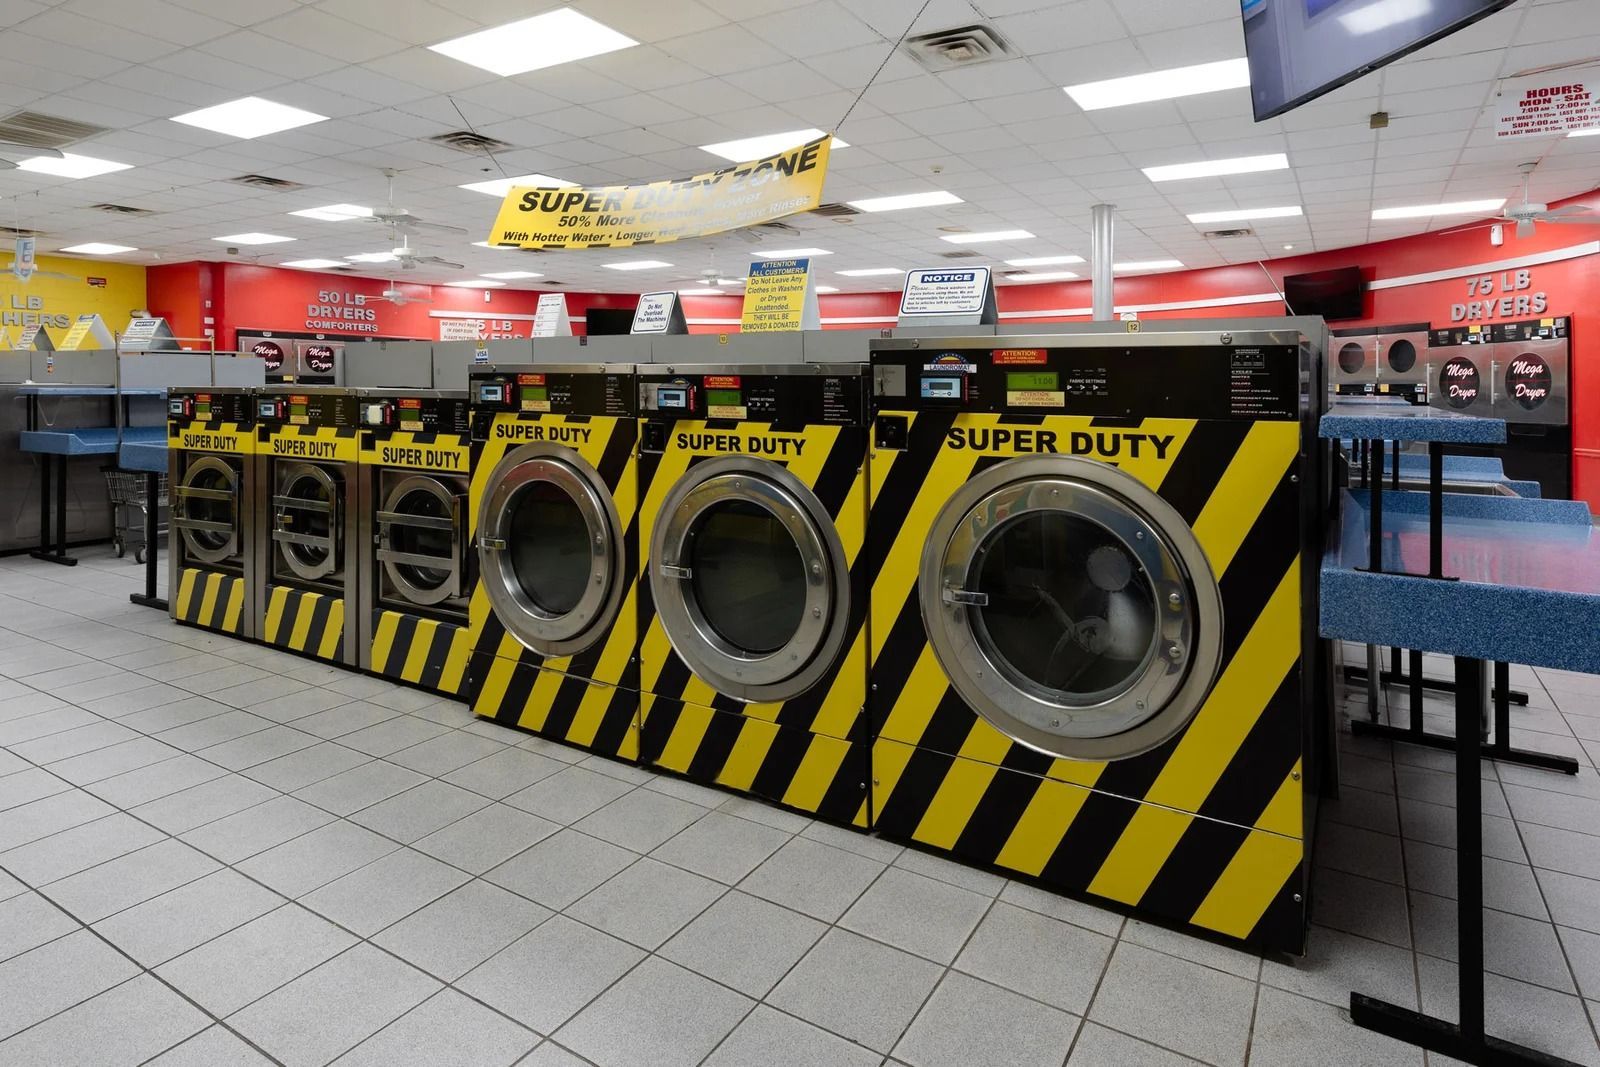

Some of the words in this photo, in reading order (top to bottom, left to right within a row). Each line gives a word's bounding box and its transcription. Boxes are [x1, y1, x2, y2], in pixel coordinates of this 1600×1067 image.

[1527, 84, 1584, 98] HOURS
[1519, 97, 1552, 107] MON
[1564, 92, 1592, 102] SAT
[1556, 101, 1579, 110] 12:00
[1565, 115, 1589, 123] 10:30
[518, 190, 625, 214] SUPER
[632, 175, 723, 210] DUTY
[728, 144, 820, 192] ZONE
[558, 215, 590, 228] 50%
[596, 214, 636, 226] More
[503, 231, 529, 241] With
[532, 232, 568, 242] Hotter
[572, 232, 605, 242] Water
[616, 230, 653, 241] Longer
[762, 260, 796, 268] ATTENTION
[765, 268, 804, 276] CUSTOMERS
[924, 274, 972, 282] NOTICE
[790, 276, 802, 284] Any
[1466, 276, 1494, 296] 75
[1501, 269, 1531, 292] LB
[11, 294, 44, 310] LB
[318, 290, 340, 303] 50
[345, 292, 366, 306] LB
[768, 295, 787, 303] Dryers
[308, 304, 376, 321] DRYERS
[1451, 291, 1548, 322] DRYERS
[306, 320, 378, 332] COMFORTERS
[492, 320, 513, 332] LB
[254, 346, 278, 356] Mega
[309, 348, 330, 357] Mega
[265, 360, 280, 369] ryer
[311, 360, 332, 369] Dryer
[1447, 364, 1475, 378] Mega
[1512, 360, 1543, 375] Mega
[1449, 384, 1476, 399] Dryer
[1515, 383, 1547, 398] Dryer
[496, 424, 544, 440] SUPER
[549, 427, 591, 443] DUTY
[184, 434, 211, 448] SUPER
[214, 436, 238, 450] DUTY
[274, 439, 306, 455] SUPER
[309, 441, 337, 458] DUTY
[677, 433, 742, 452] SUPER
[748, 436, 806, 456] DUTY
[947, 428, 1058, 453] SUPER
[1071, 431, 1175, 459] DUTY
[382, 447, 422, 465] SUPER
[426, 450, 460, 468] DUTY
